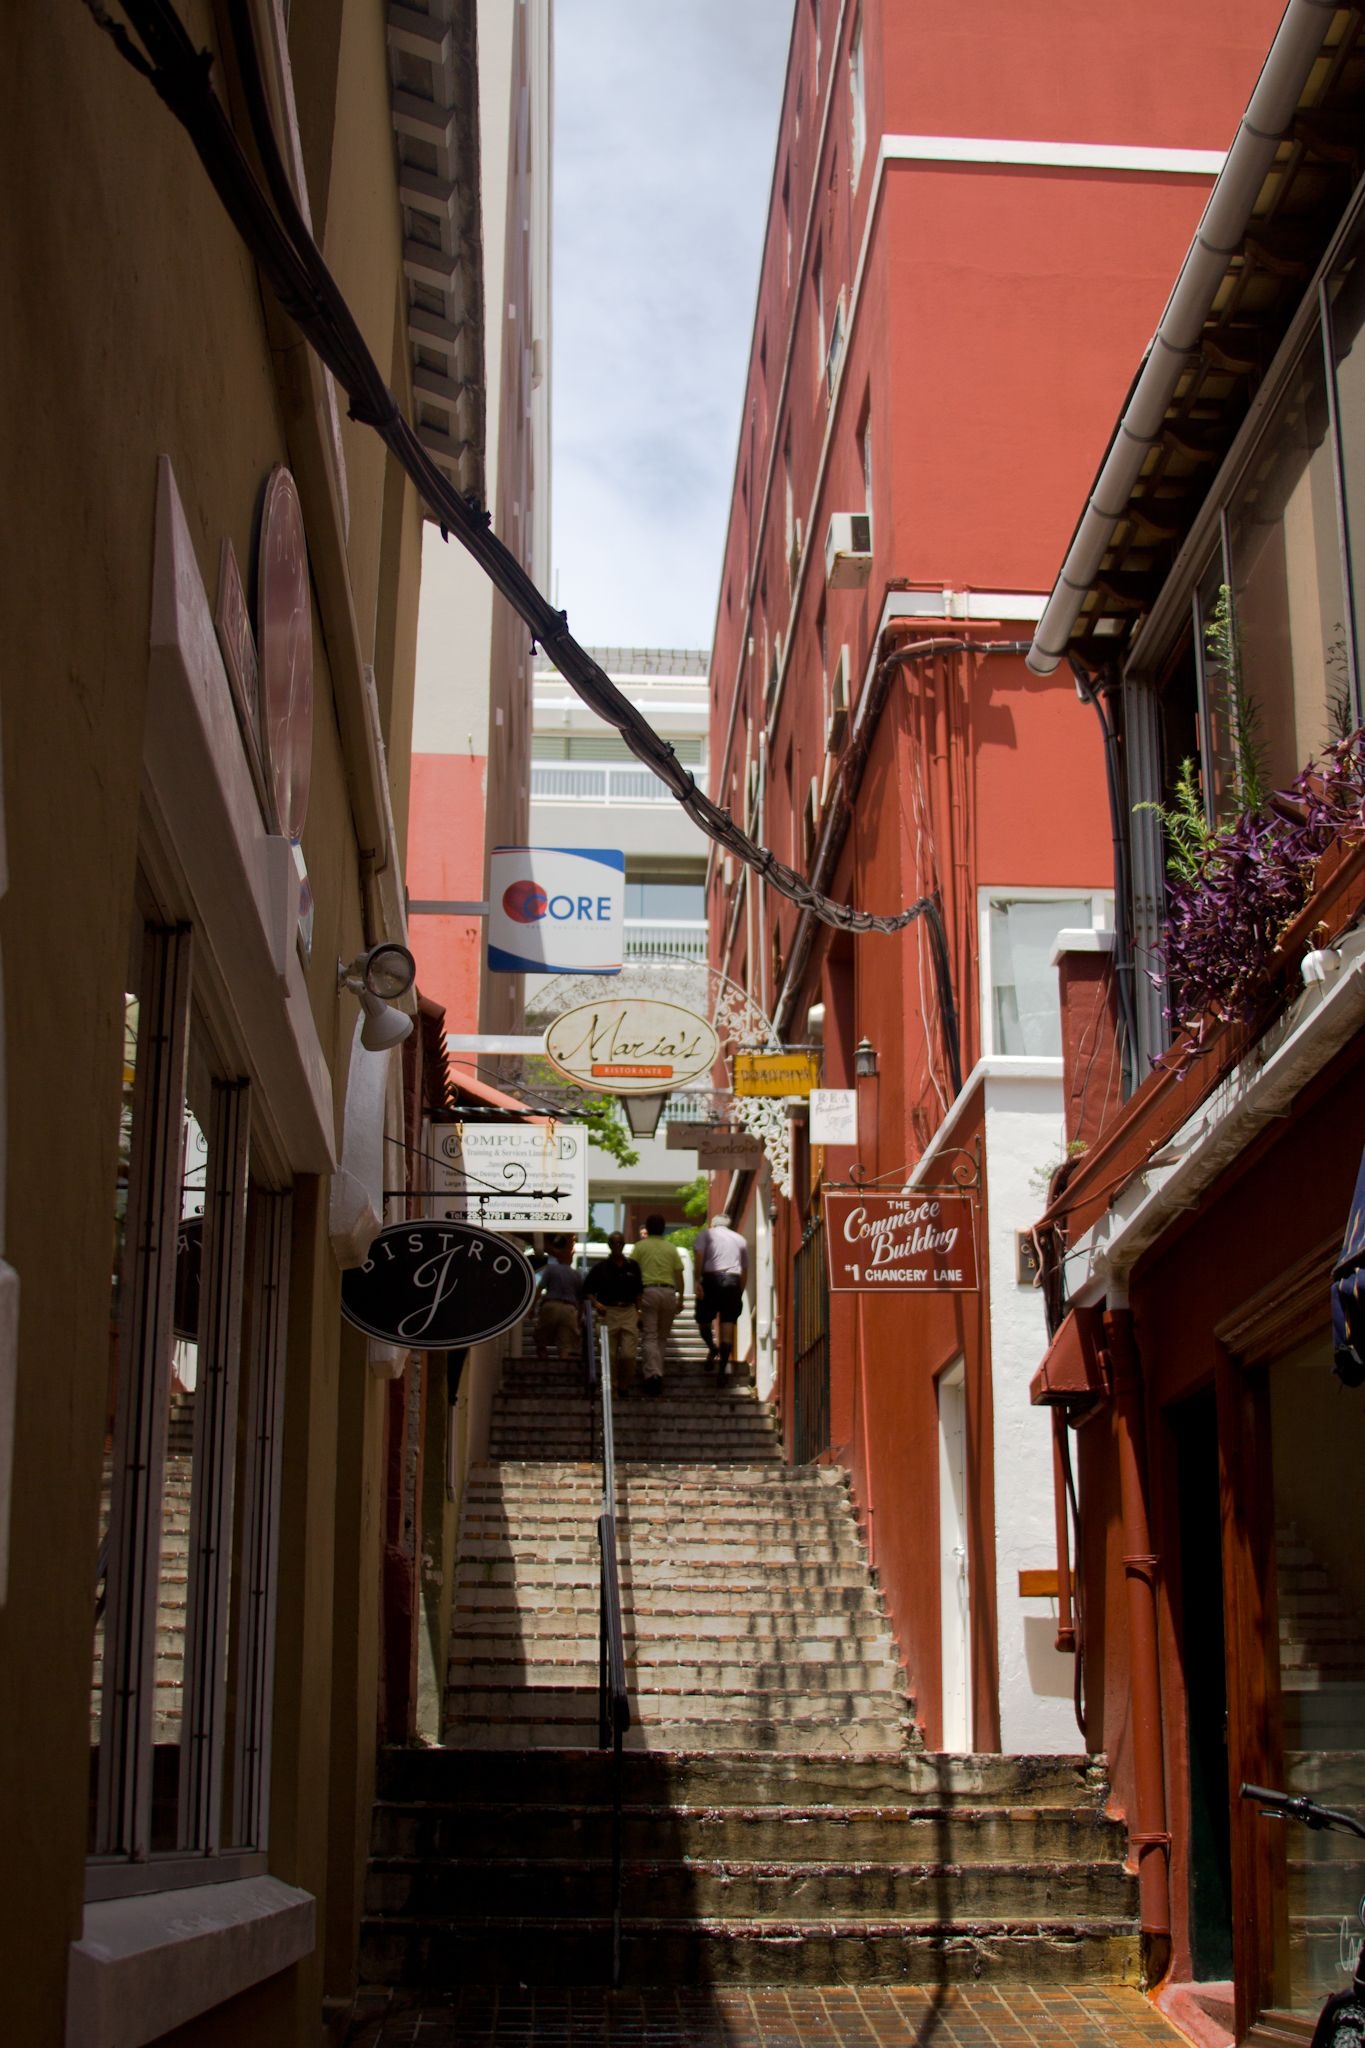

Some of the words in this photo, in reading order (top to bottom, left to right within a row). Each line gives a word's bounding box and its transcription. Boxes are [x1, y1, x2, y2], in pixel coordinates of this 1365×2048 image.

[523, 894, 612, 921] CORE
[557, 1011, 701, 1061] Maria's
[604, 1066, 662, 1076] RISTORANTE
[510, 1211, 529, 1220] Fax.
[887, 1200, 911, 1210] THE
[843, 1201, 940, 1243] Commerce
[871, 1223, 959, 1266] Building
[864, 1269, 928, 1281] CHANCERY
[933, 1269, 963, 1281] LANE
[397, 1243, 465, 1338] J
